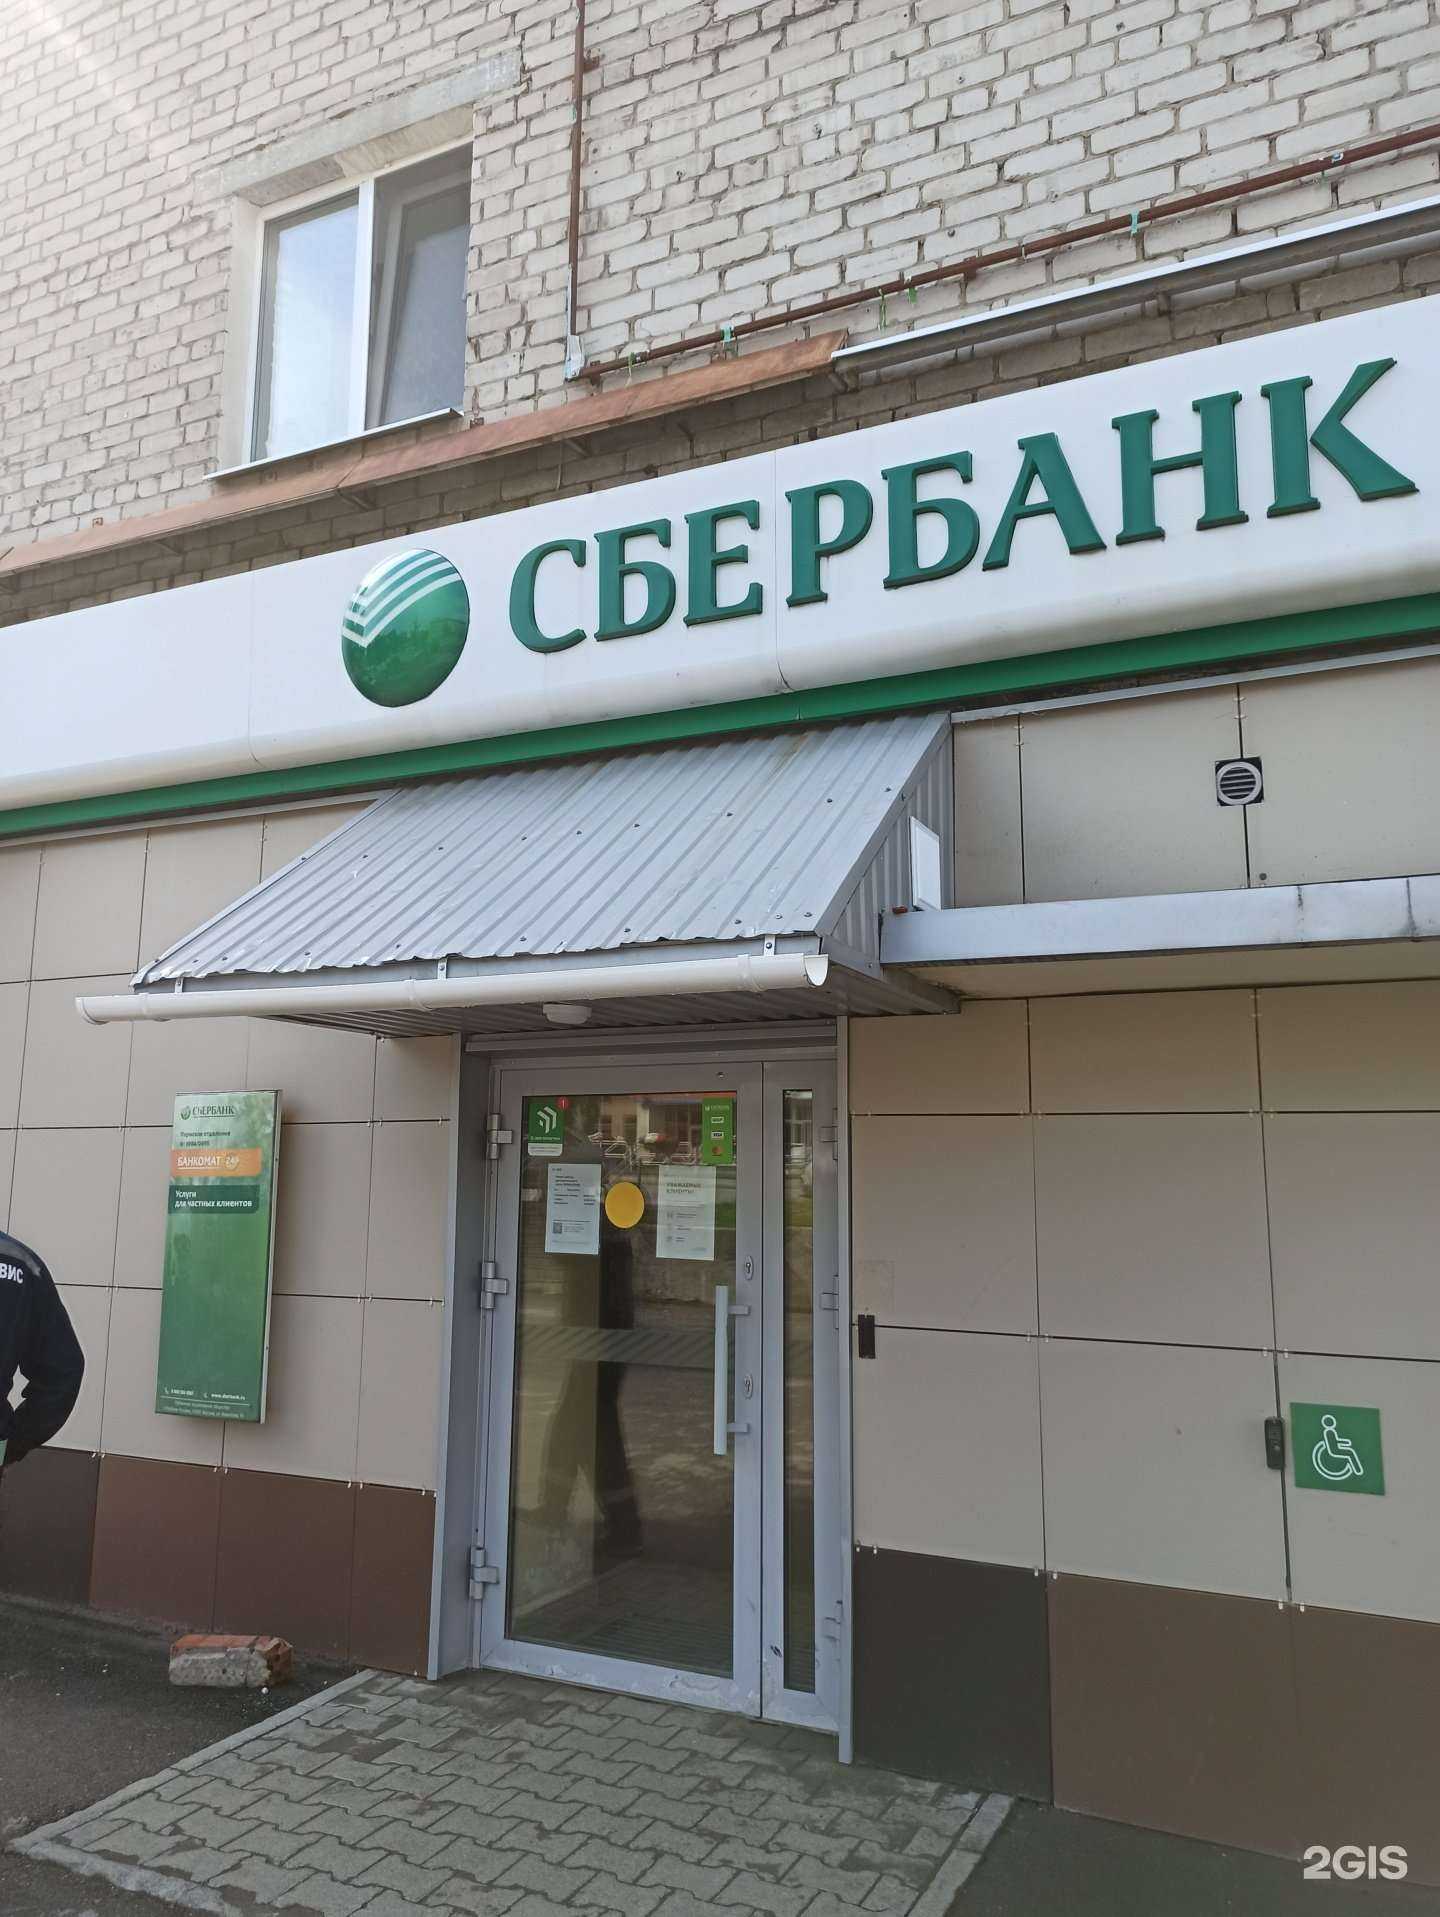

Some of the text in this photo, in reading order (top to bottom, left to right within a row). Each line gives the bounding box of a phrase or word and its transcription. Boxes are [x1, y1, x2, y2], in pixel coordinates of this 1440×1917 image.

[508, 357, 1420, 654] СБЕРБАНК
[192, 1104, 235, 1116] СБЕРБАНК
[177, 1156, 221, 1168] БАНКОМАТ
[175, 1190, 197, 1200] Услуги
[174, 1201, 187, 1209] для
